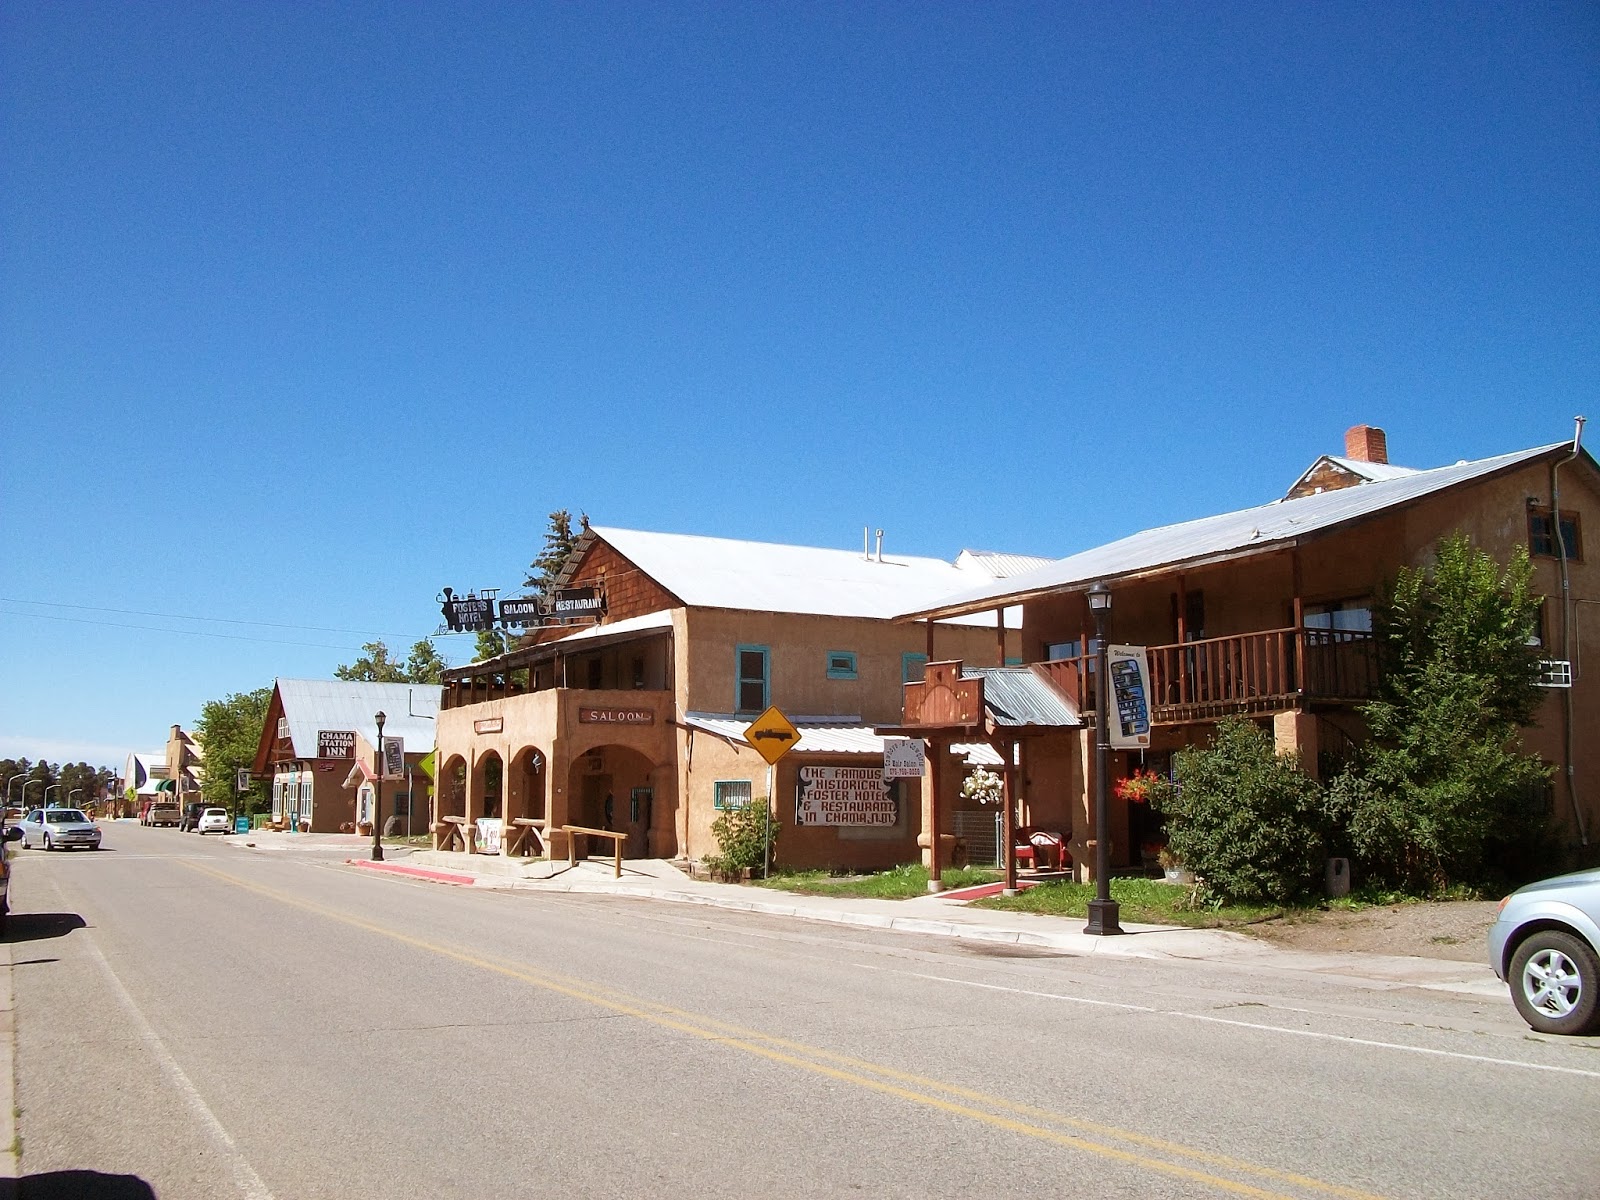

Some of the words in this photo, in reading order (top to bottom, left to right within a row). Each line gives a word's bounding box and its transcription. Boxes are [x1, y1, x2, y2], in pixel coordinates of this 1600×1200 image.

[503, 603, 535, 615] SALOON
[555, 599, 602, 611] RESTAURANT
[458, 612, 484, 624] HOTEL
[590, 711, 645, 721] SALOON
[321, 732, 353, 740] CHAMA
[326, 747, 347, 756] INN
[804, 768, 825, 778] THE
[835, 769, 882, 779] FAMOUS
[816, 780, 882, 790] HISTORICAL
[807, 790, 849, 800] FOSTER
[855, 791, 887, 801] HOTEL
[803, 801, 811, 811] &
[805, 812, 816, 822] IN
